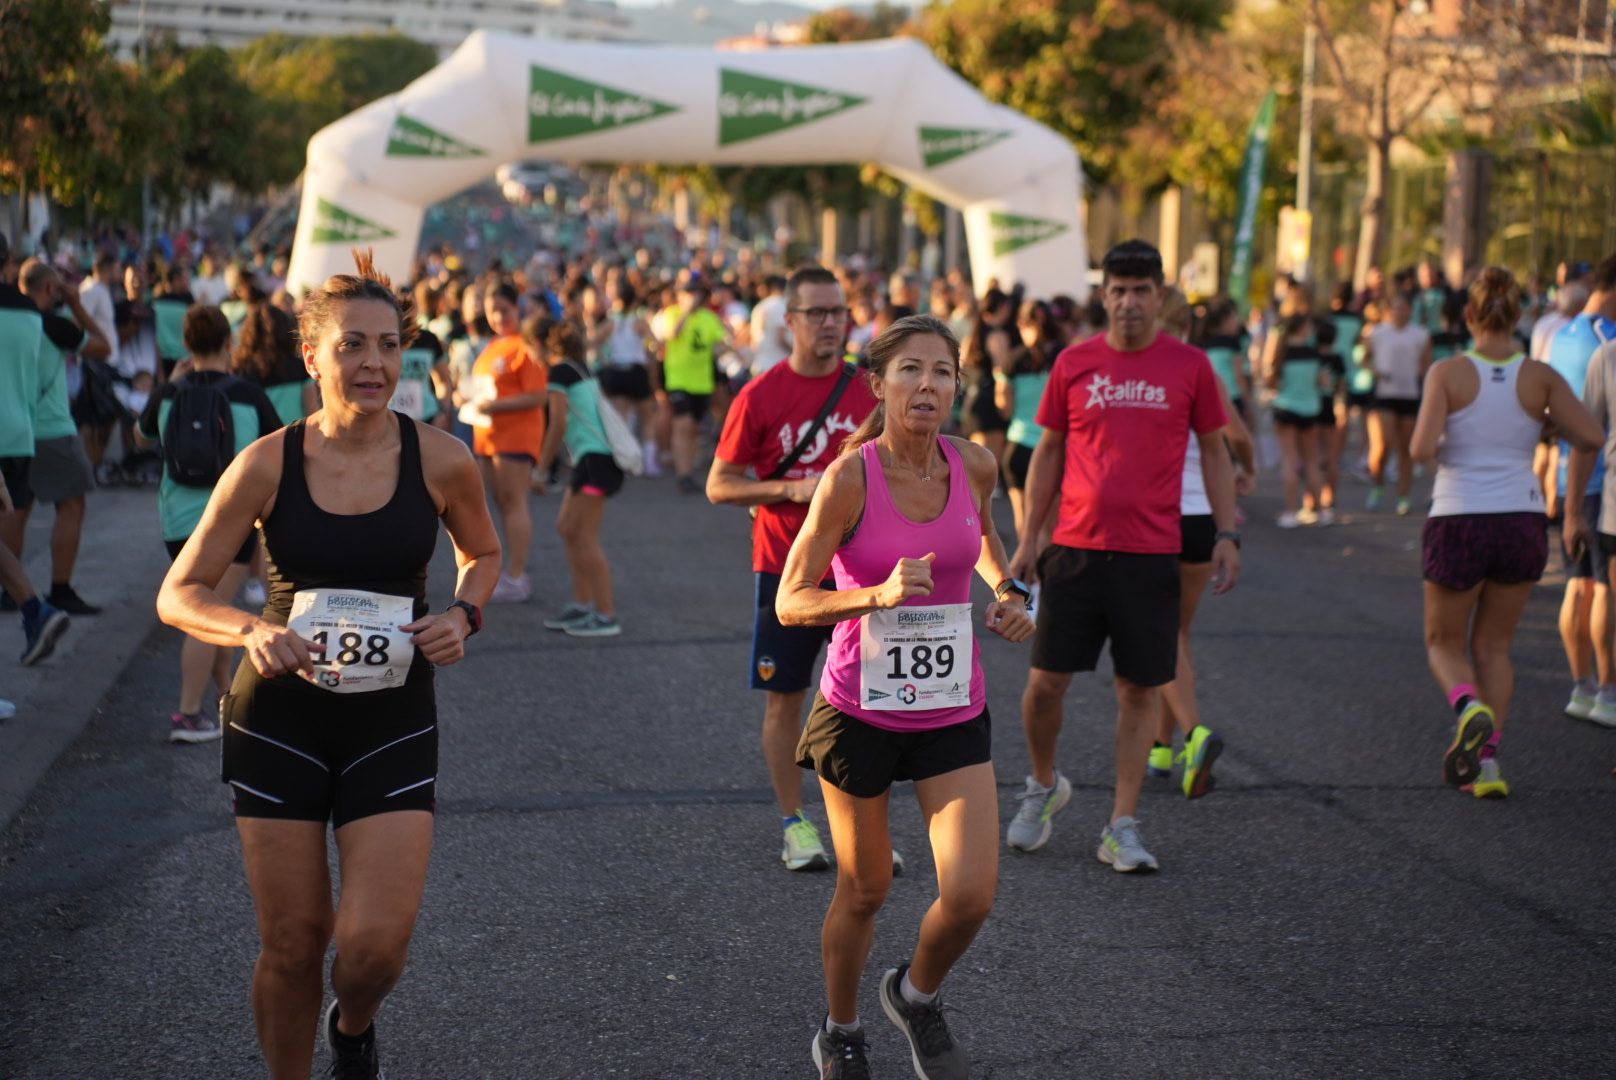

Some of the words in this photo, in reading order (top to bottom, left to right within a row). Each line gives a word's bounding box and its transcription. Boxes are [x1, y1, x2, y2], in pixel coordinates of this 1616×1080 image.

[1104, 379, 1166, 402] califas
[312, 631, 390, 666] 188
[887, 645, 954, 679] 189
